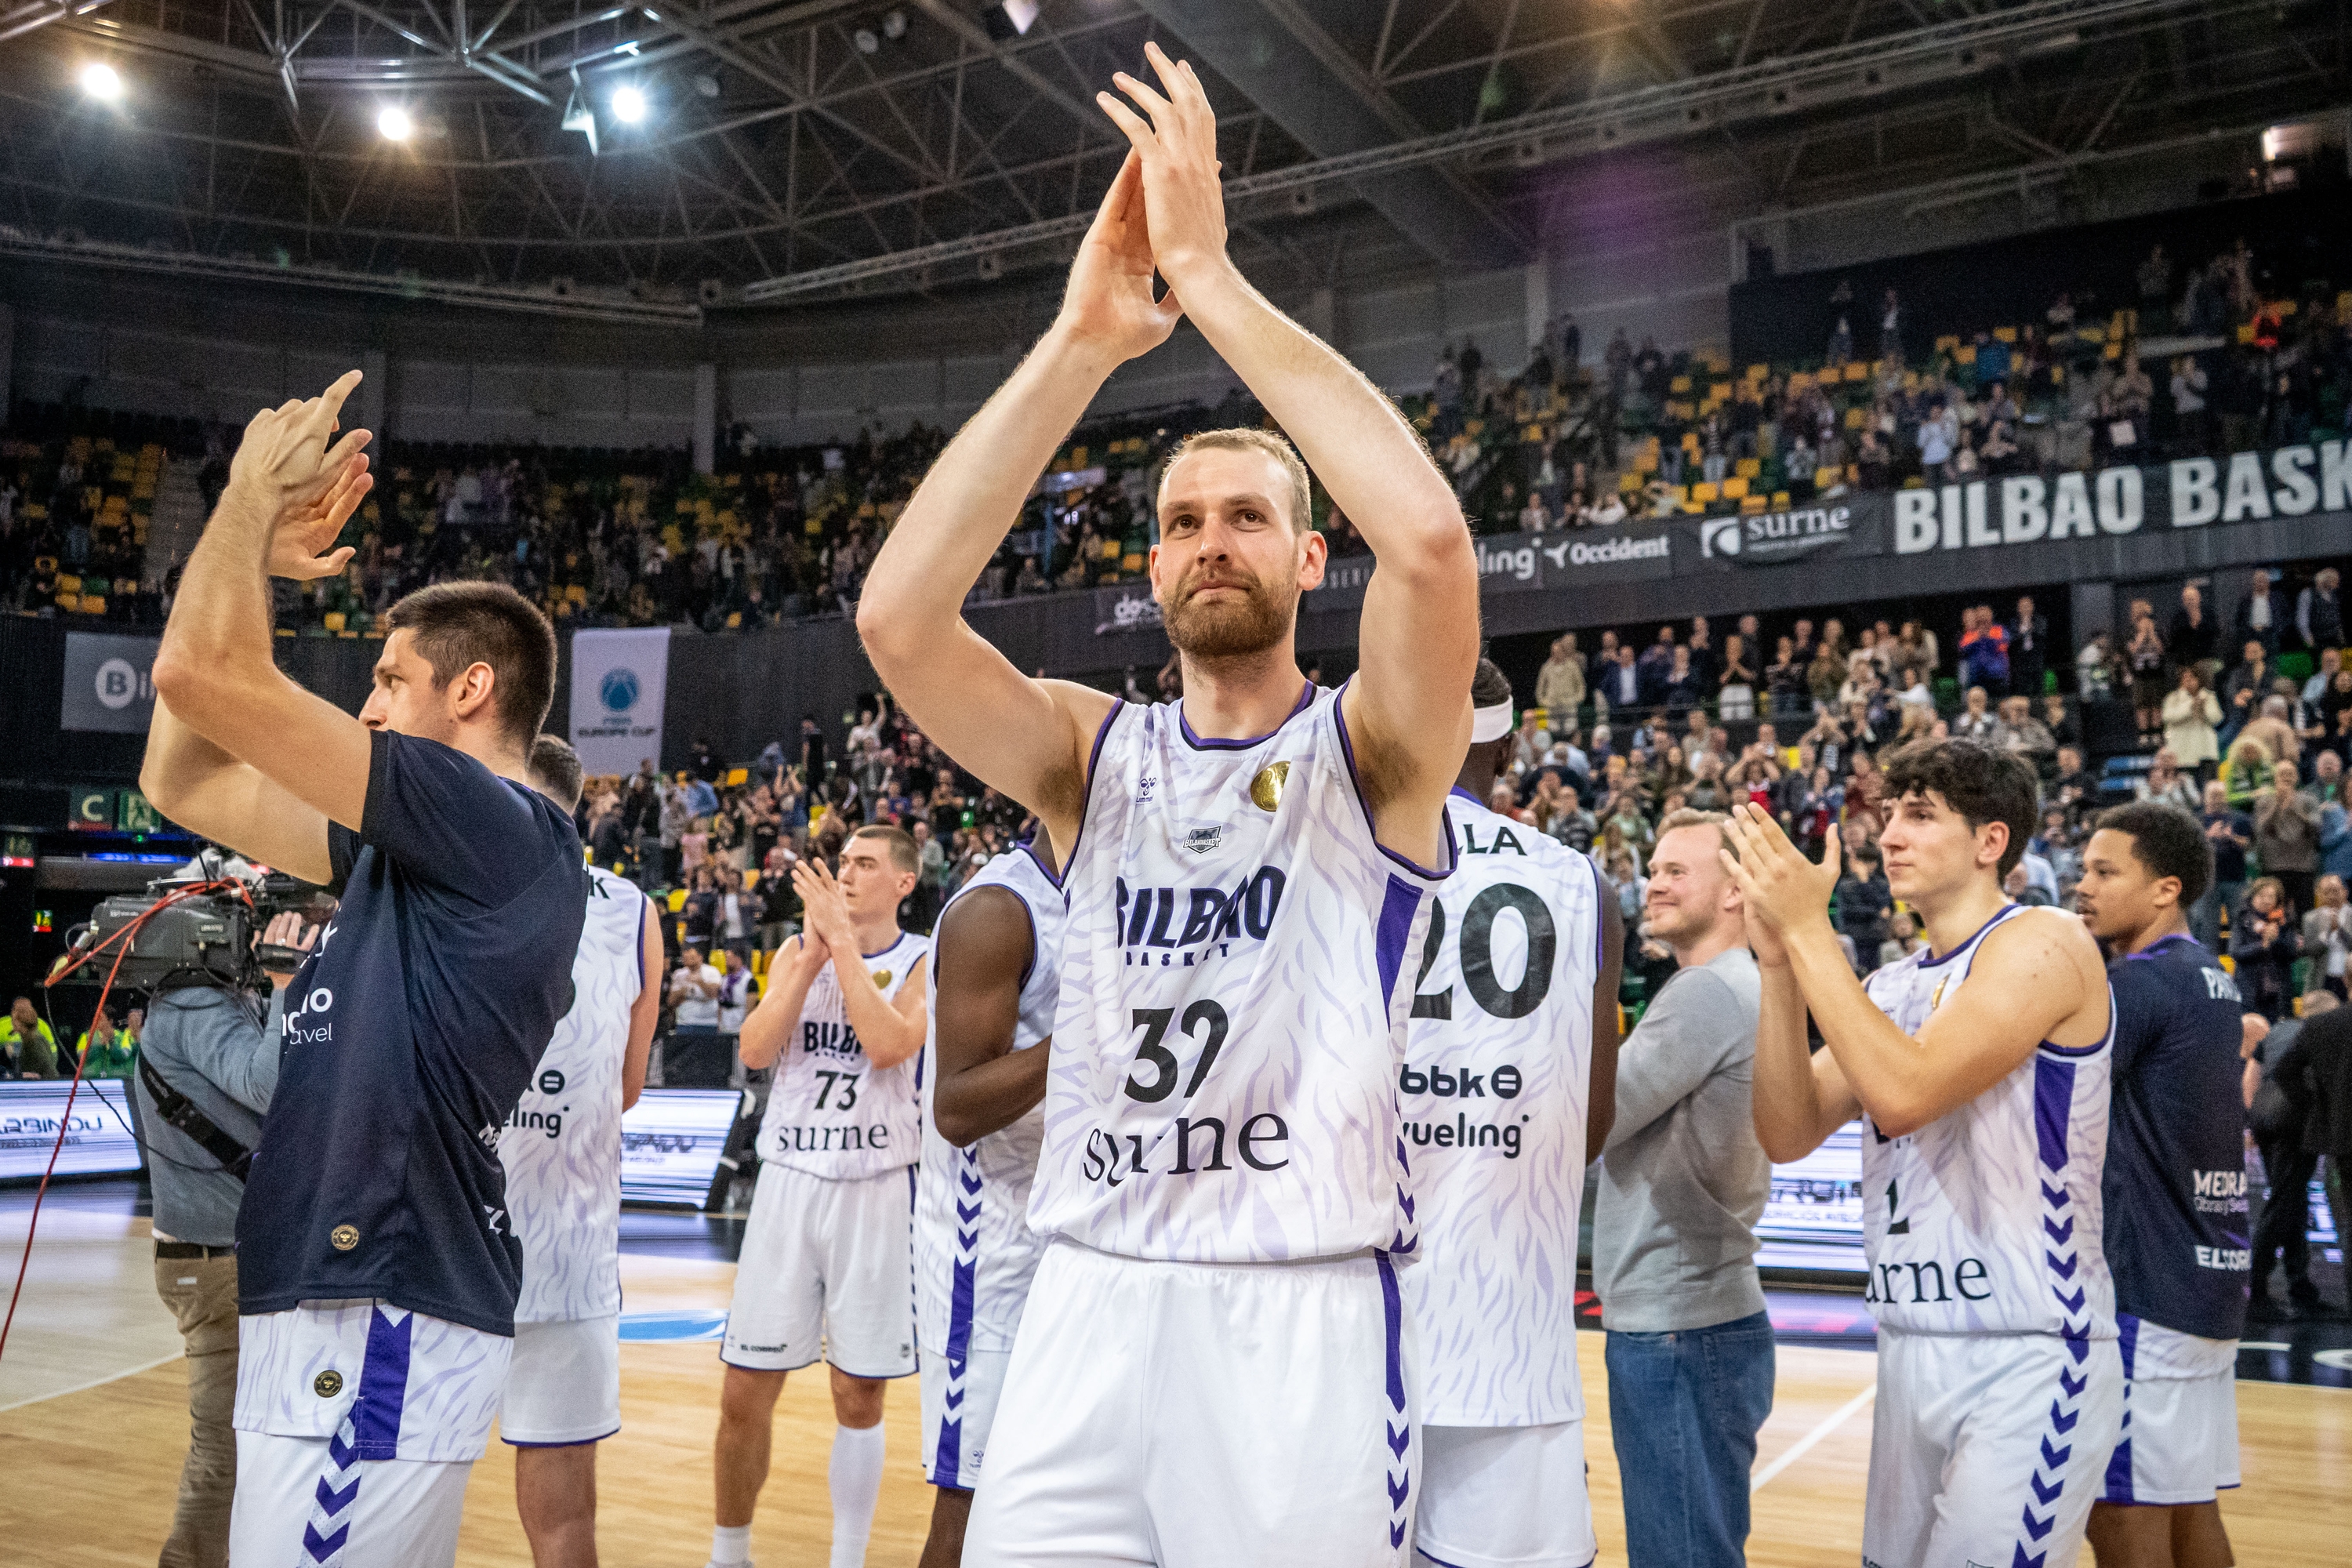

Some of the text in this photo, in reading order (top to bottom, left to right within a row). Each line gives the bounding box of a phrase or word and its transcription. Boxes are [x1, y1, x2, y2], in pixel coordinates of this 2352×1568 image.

[1894, 437, 2352, 554] BILBAO BASK
[1748, 506, 1850, 541] surne
[1570, 535, 1670, 565] Occident
[81, 794, 104, 822] C
[1457, 823, 1529, 856] LA
[1126, 943, 1229, 967] BASKT
[1410, 883, 1556, 1020] 20
[815, 1070, 861, 1112] 73
[1399, 1063, 1486, 1098] bbk
[777, 1123, 888, 1151] surne
[1083, 1112, 1289, 1187] sune
